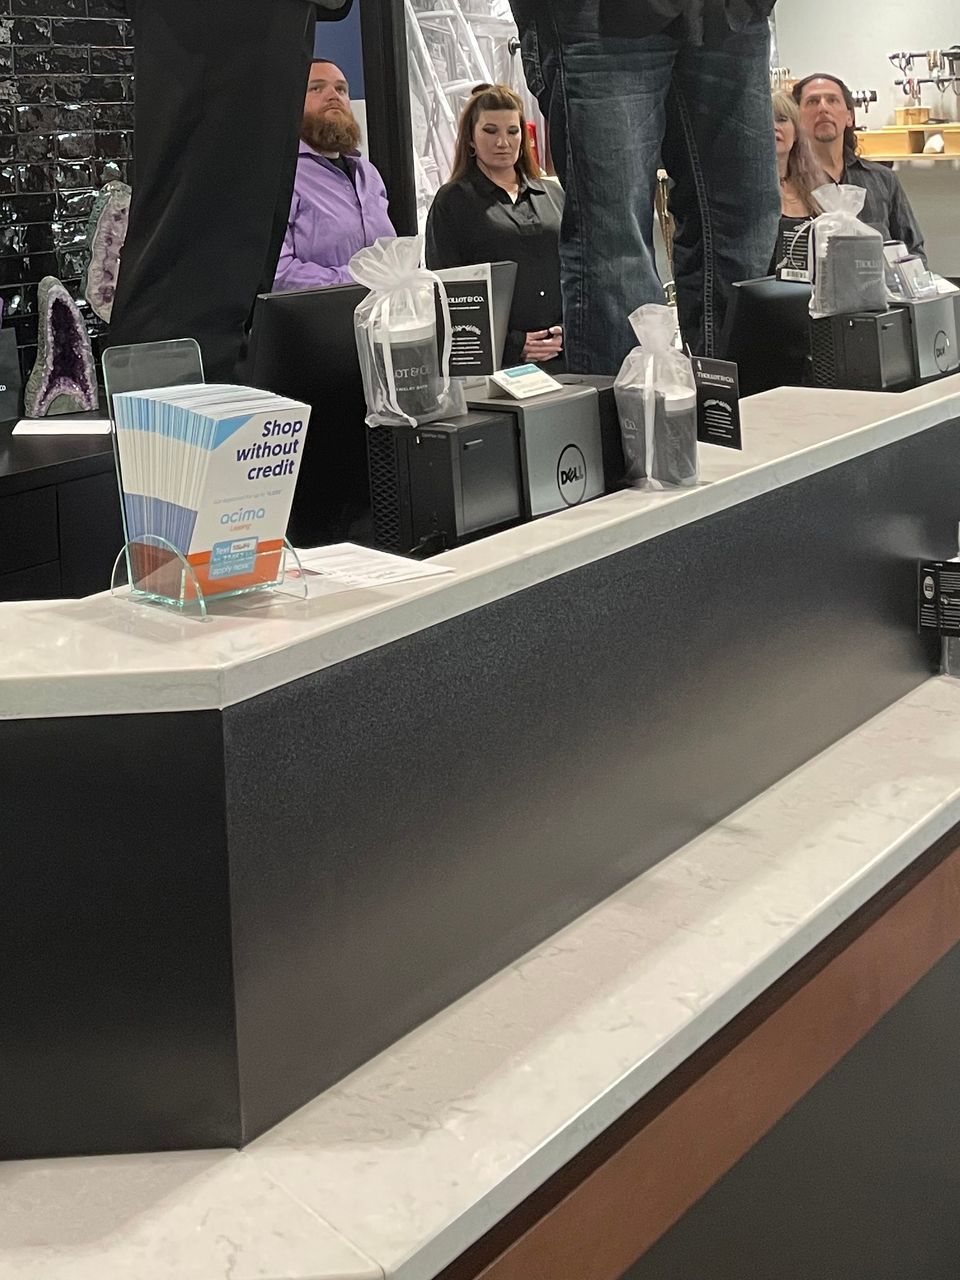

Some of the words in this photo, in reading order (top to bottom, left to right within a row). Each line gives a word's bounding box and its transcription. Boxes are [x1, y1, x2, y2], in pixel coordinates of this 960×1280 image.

[262, 420, 303, 438] Shop
[236, 439, 299, 462] without
[247, 460, 295, 480] credit
[560, 465, 583, 485] DELL
[220, 507, 265, 525] acima
